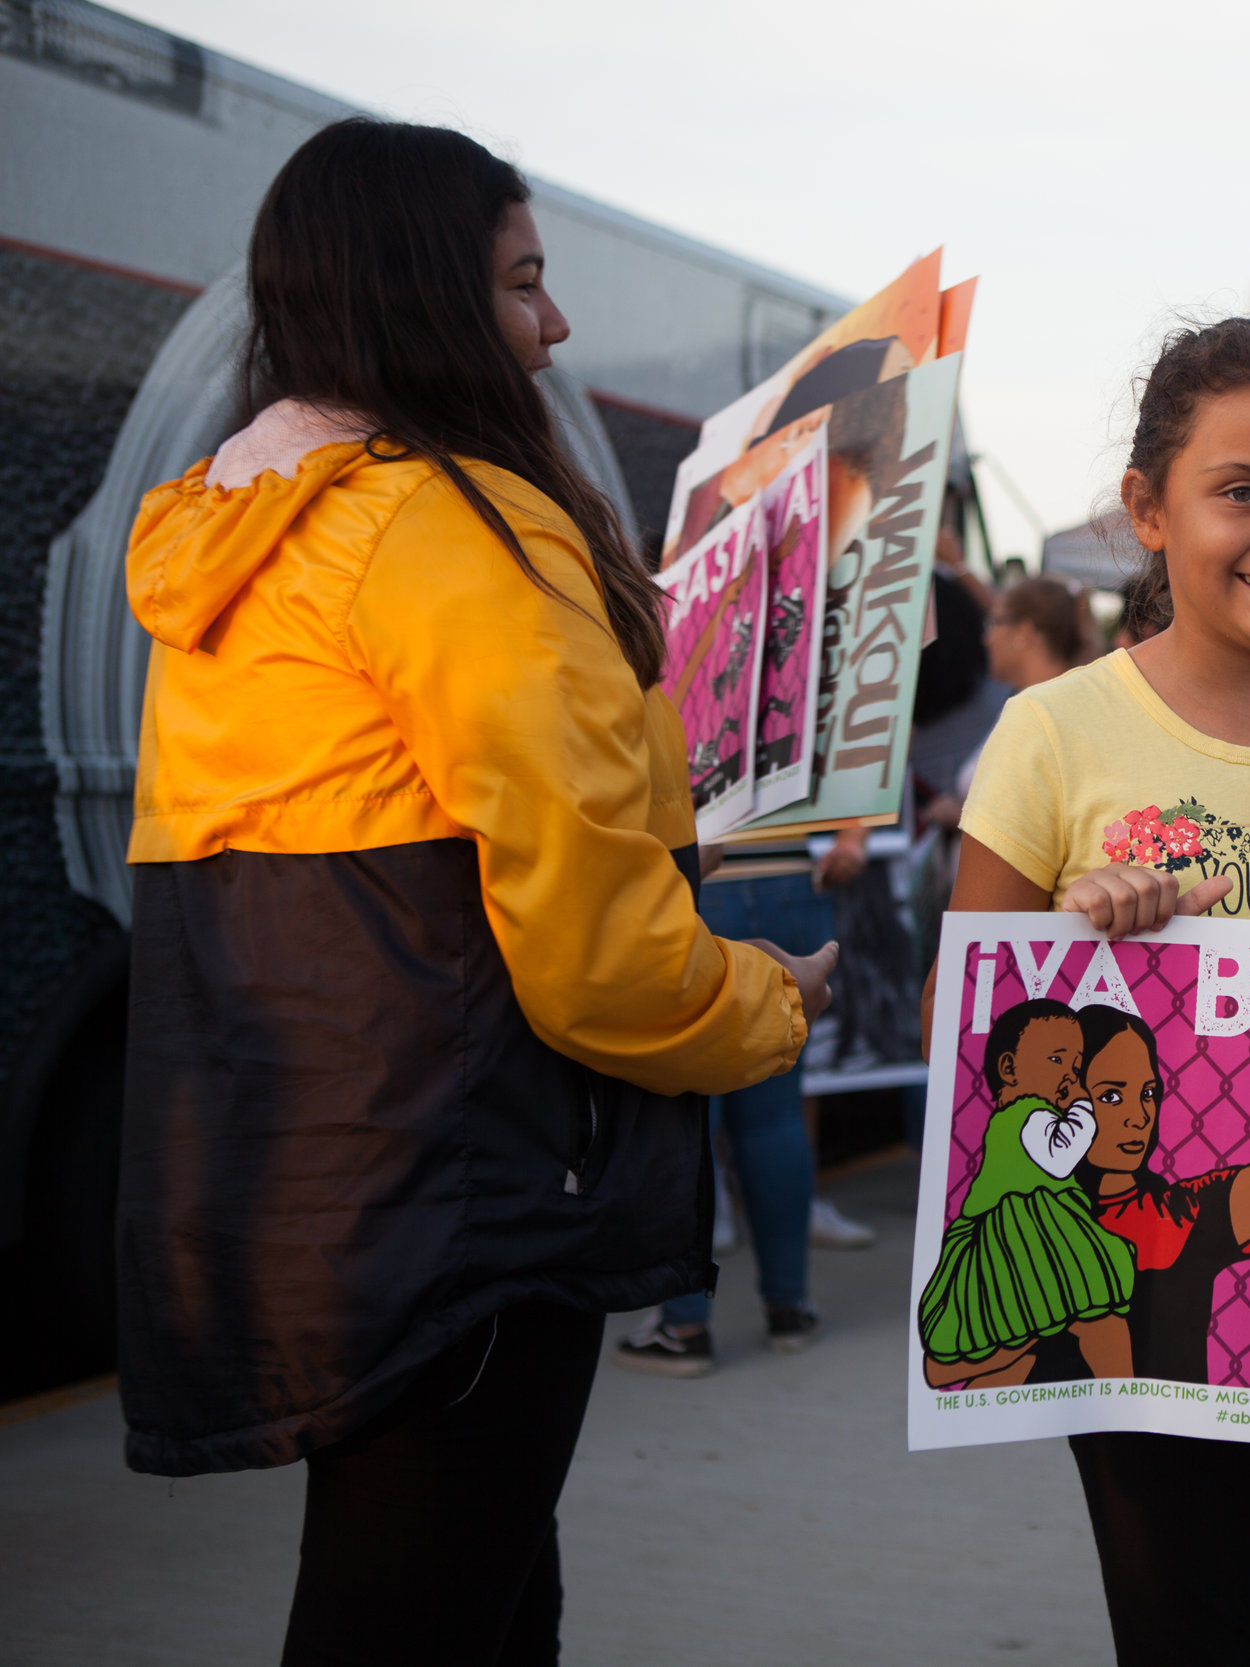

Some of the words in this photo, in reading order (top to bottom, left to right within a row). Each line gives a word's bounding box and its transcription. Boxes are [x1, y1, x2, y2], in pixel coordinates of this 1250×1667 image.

[834, 439, 938, 789] WALKOUT
[935, 1396, 960, 1411] THE
[965, 1394, 991, 1409] U.S.
[995, 1383, 1094, 1406] GOVERNMENT
[1099, 1382, 1113, 1397] IS
[1118, 1382, 1209, 1403] ABDUCTING
